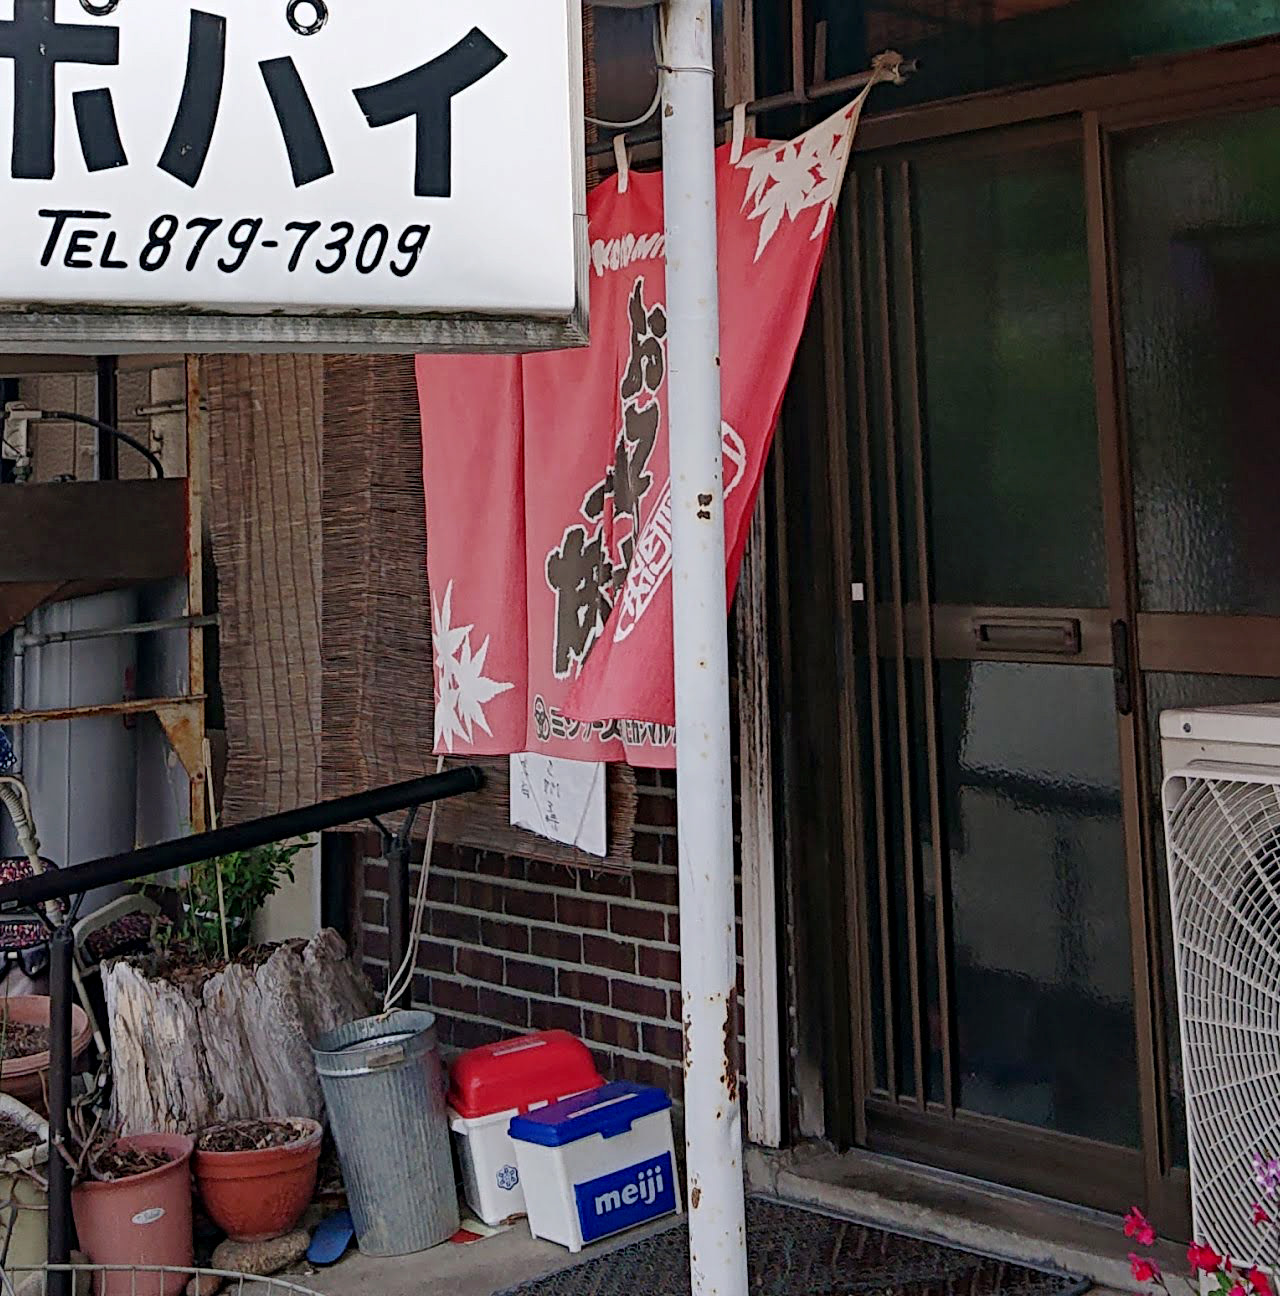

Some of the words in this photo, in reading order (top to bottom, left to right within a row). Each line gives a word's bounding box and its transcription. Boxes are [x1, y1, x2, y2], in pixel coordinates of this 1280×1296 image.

[37, 209, 127, 269] TEL
[139, 215, 433, 277] 879-7309
[594, 1164, 665, 1216] meiji
